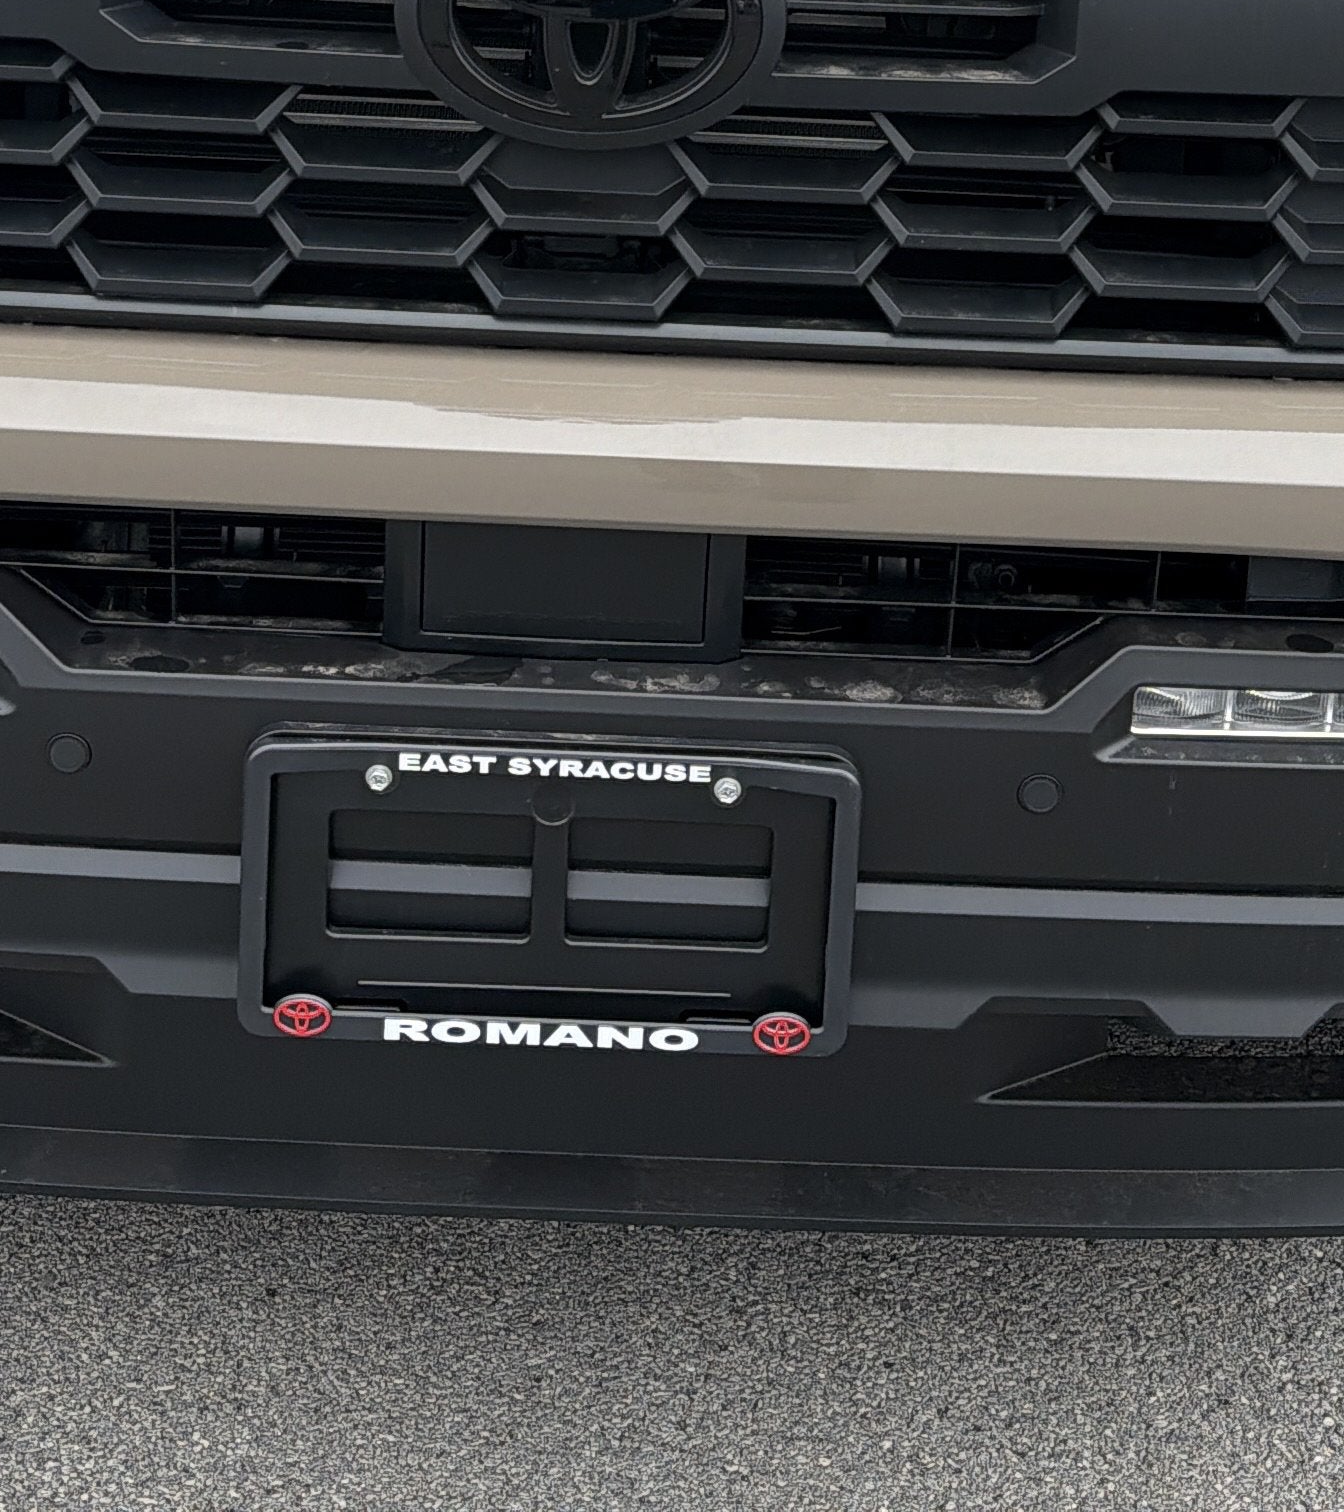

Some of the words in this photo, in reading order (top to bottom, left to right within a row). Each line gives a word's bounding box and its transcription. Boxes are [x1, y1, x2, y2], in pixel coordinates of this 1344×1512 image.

[398, 752, 497, 774] EAST
[507, 757, 711, 783] SYRACUSE
[383, 1017, 699, 1052] ROMANO
